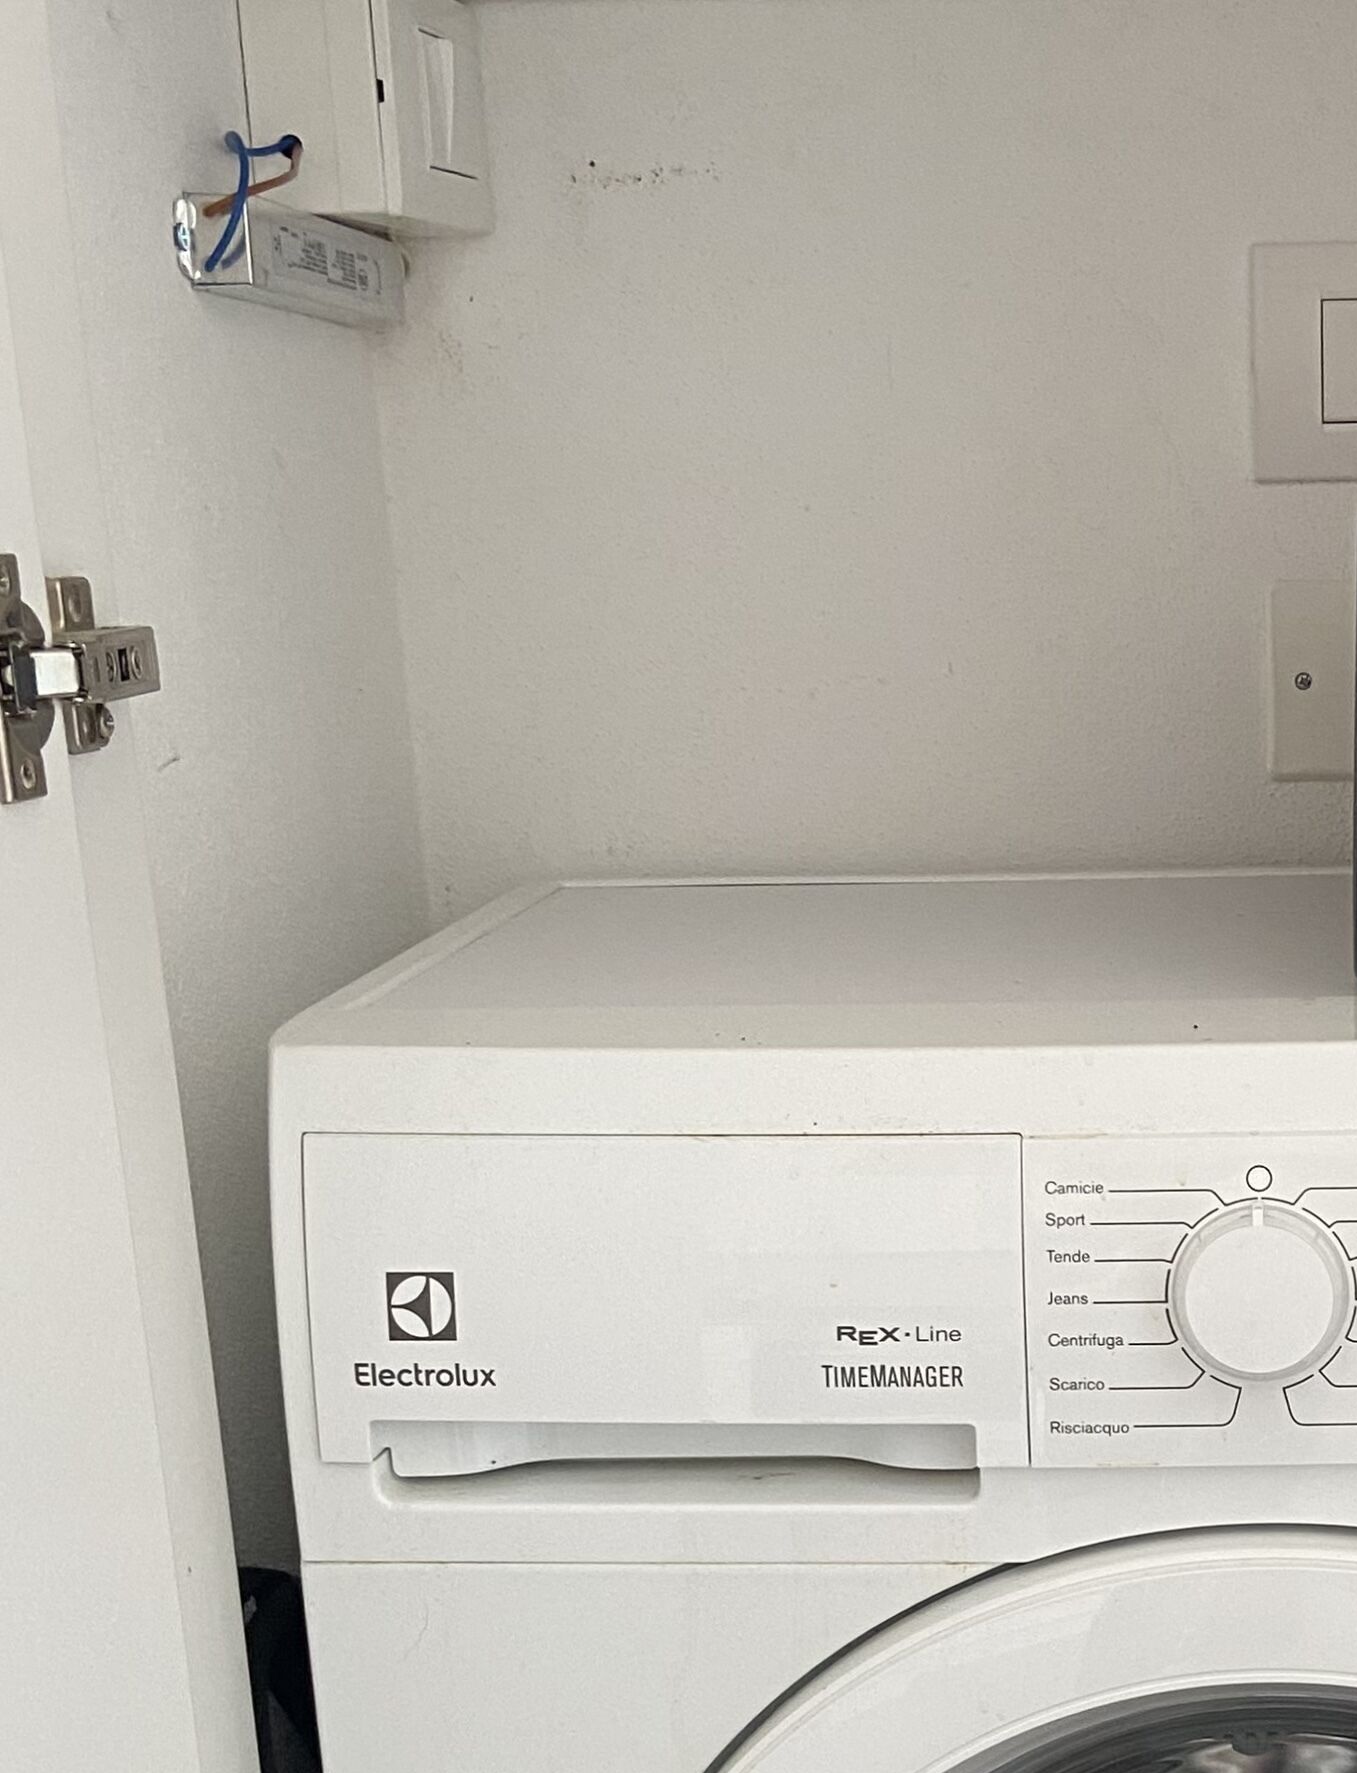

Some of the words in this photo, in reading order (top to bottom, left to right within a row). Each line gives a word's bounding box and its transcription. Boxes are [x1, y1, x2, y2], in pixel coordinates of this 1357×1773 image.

[1045, 1181, 1103, 1194] Camicie
[1046, 1213, 1085, 1228] Sport
[1046, 1250, 1090, 1263] Tende
[1048, 1292, 1088, 1305] Jeans
[916, 1326, 961, 1341] Line
[1048, 1333, 1124, 1350] Centrifuga
[354, 1363, 496, 1386] Electrolux
[1050, 1378, 1104, 1391] Scarico
[1050, 1421, 1129, 1436] Risciacquo
